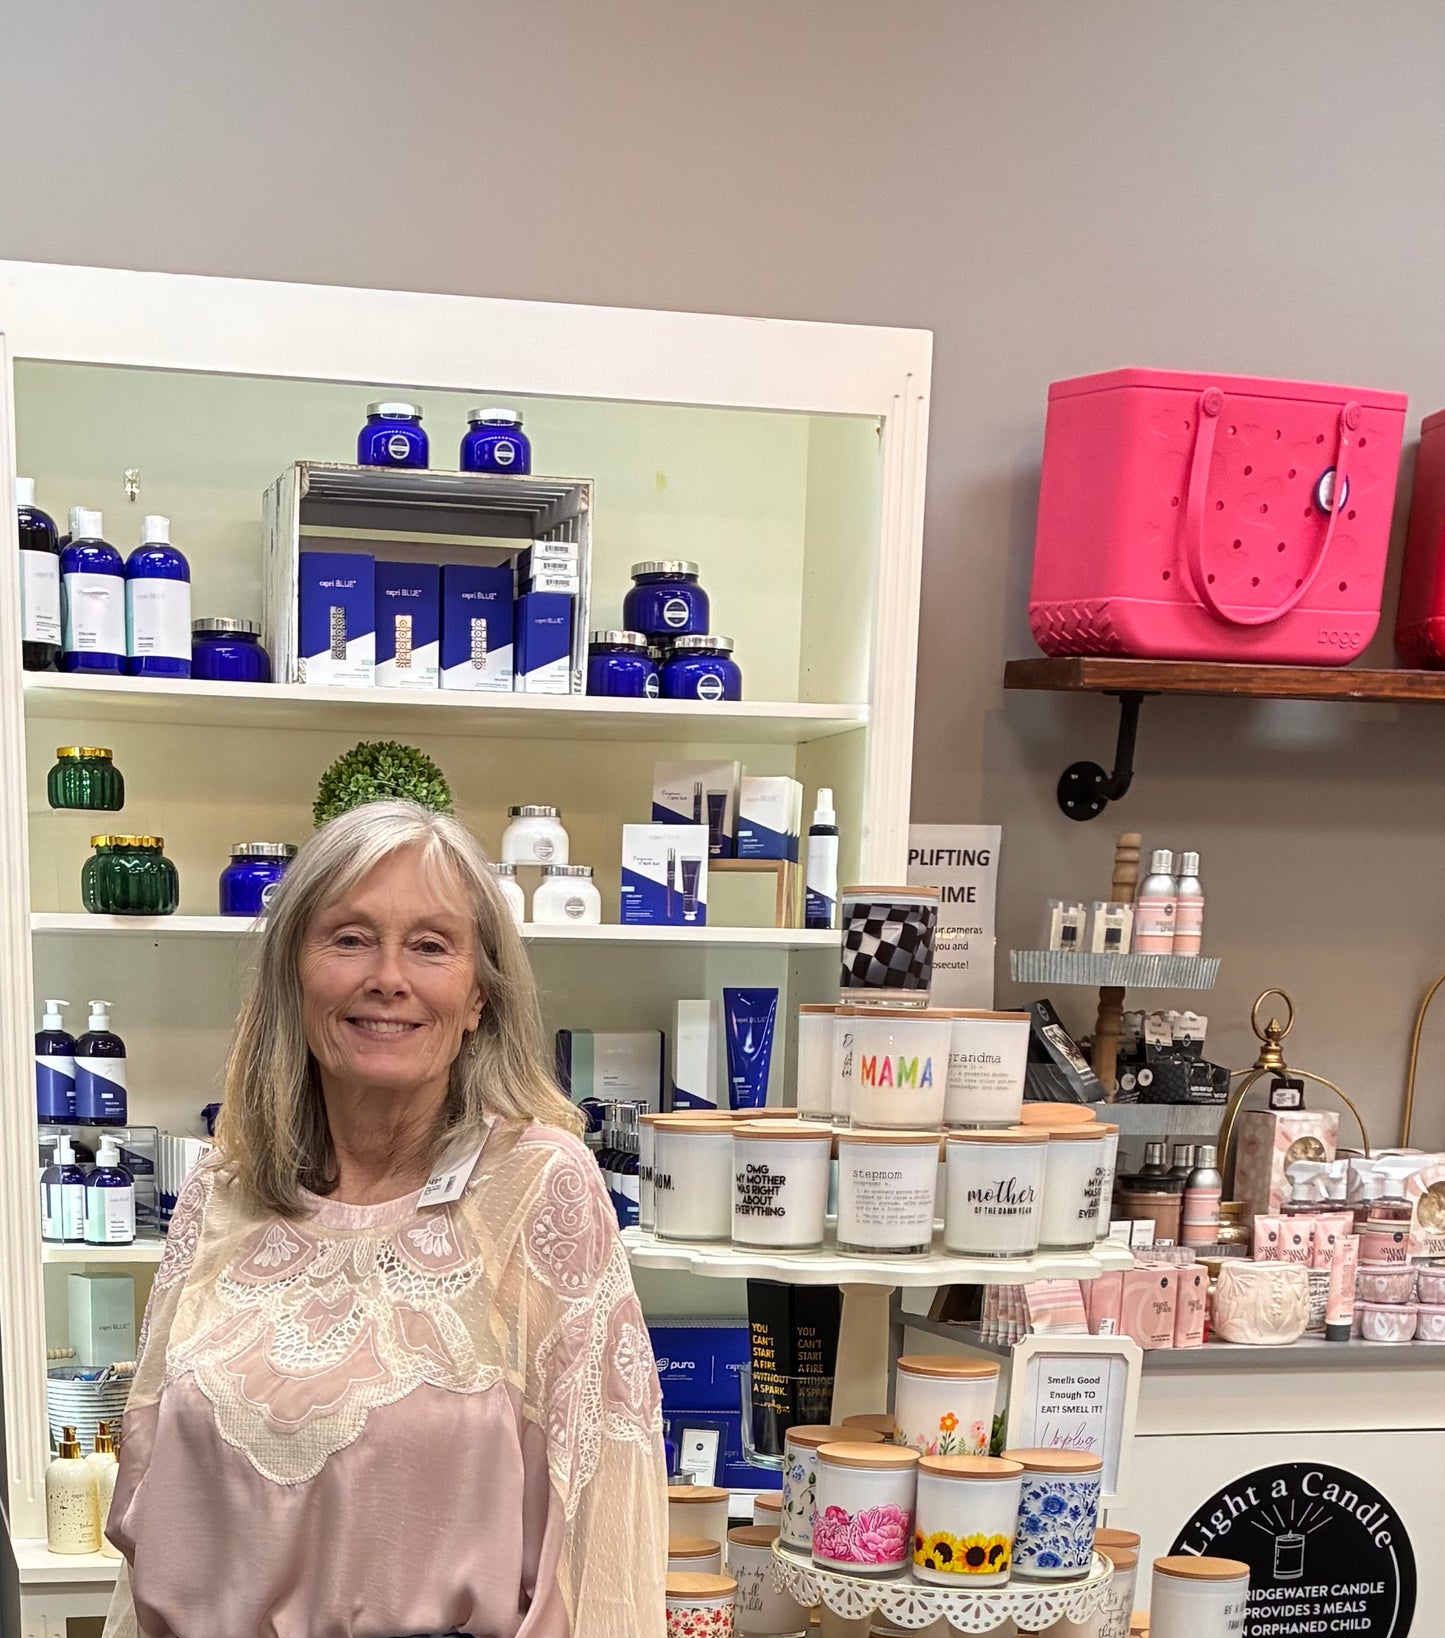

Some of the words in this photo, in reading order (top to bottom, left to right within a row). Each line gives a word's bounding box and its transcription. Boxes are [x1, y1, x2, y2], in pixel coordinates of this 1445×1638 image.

[1318, 628, 1360, 650] bogg
[908, 849, 990, 866] PLIFTING
[941, 886, 977, 903] IME
[935, 926, 944, 934] ur
[947, 926, 983, 935] cameras
[952, 942, 969, 951] and
[932, 962, 969, 970] osecute!
[861, 1055, 933, 1089] MAMA
[746, 1164, 770, 1174] OMG
[736, 1174, 745, 1183] MY
[746, 1175, 786, 1186] MOTHER
[852, 1169, 903, 1181] stepmom
[737, 1185, 750, 1195] WAS
[752, 1186, 780, 1197] RIGHT
[967, 1177, 1037, 1205] mother
[742, 1196, 774, 1206] ABOUT
[735, 1204, 786, 1217] EVERYTHING
[984, 1207, 996, 1215] THE
[998, 1207, 1017, 1215] DAMN
[1018, 1207, 1032, 1215] YEAR
[752, 1323, 768, 1334] YOU
[797, 1326, 815, 1336] YOU
[752, 1336, 774, 1347] CAN'T
[798, 1339, 822, 1349] CAN'T
[753, 1348, 775, 1358] START
[798, 1351, 822, 1361] START
[670, 1361, 696, 1372] pura
[753, 1360, 759, 1369] A
[760, 1360, 776, 1371] FIRE
[798, 1363, 804, 1373] A
[806, 1363, 824, 1373] FIRE
[753, 1371, 789, 1384] WITHOUT
[1047, 1376, 1075, 1384] Smells
[1077, 1376, 1101, 1384] Good
[753, 1384, 759, 1393] A
[1050, 1391, 1081, 1400] Enough
[1084, 1391, 1096, 1399] TO
[1041, 1405, 1060, 1413] EAT!
[1091, 1405, 1103, 1413] IT!
[1180, 1486, 1261, 1557] Light
[1271, 1479, 1289, 1498] a
[1302, 1471, 1392, 1549] Candle
[1245, 1585, 1328, 1602] RIDGEWATER
[1331, 1582, 1385, 1596] CANDLE
[1244, 1605, 1310, 1619] PROVIDES
[1313, 1603, 1321, 1615] 3
[1323, 1600, 1367, 1614] MEALS
[1251, 1620, 1328, 1637] ORPHANED
[1330, 1617, 1372, 1632] CHILD
